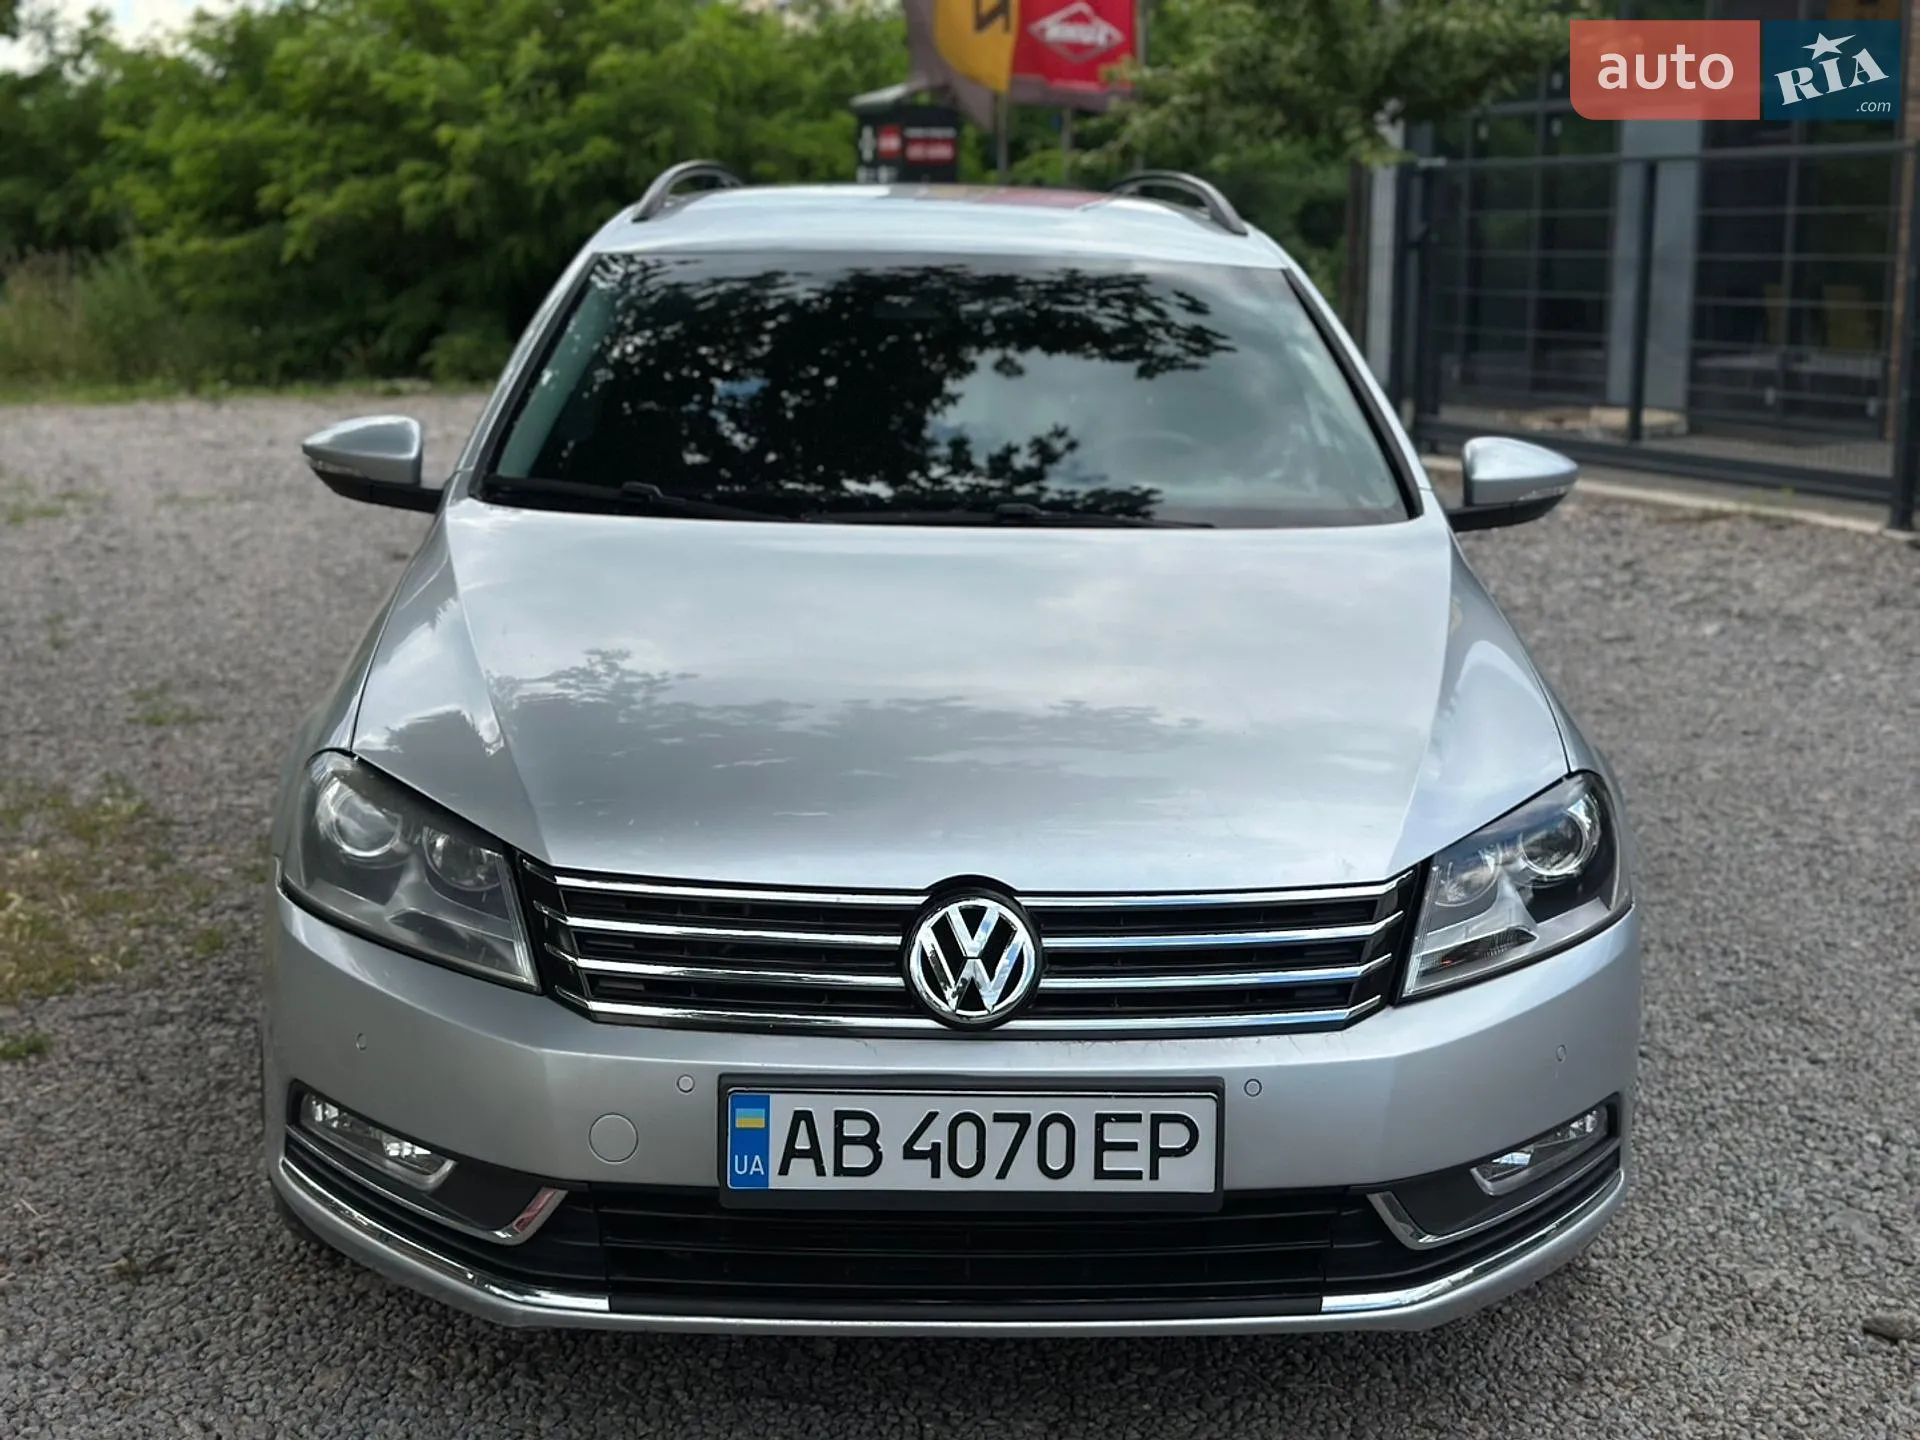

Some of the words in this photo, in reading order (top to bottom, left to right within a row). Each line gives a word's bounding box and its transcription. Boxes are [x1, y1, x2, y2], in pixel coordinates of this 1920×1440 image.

[734, 1154, 765, 1176] UA
[778, 1109, 883, 1177] AB
[902, 1110, 1077, 1180] 4070
[1093, 1113, 1200, 1181] EP
